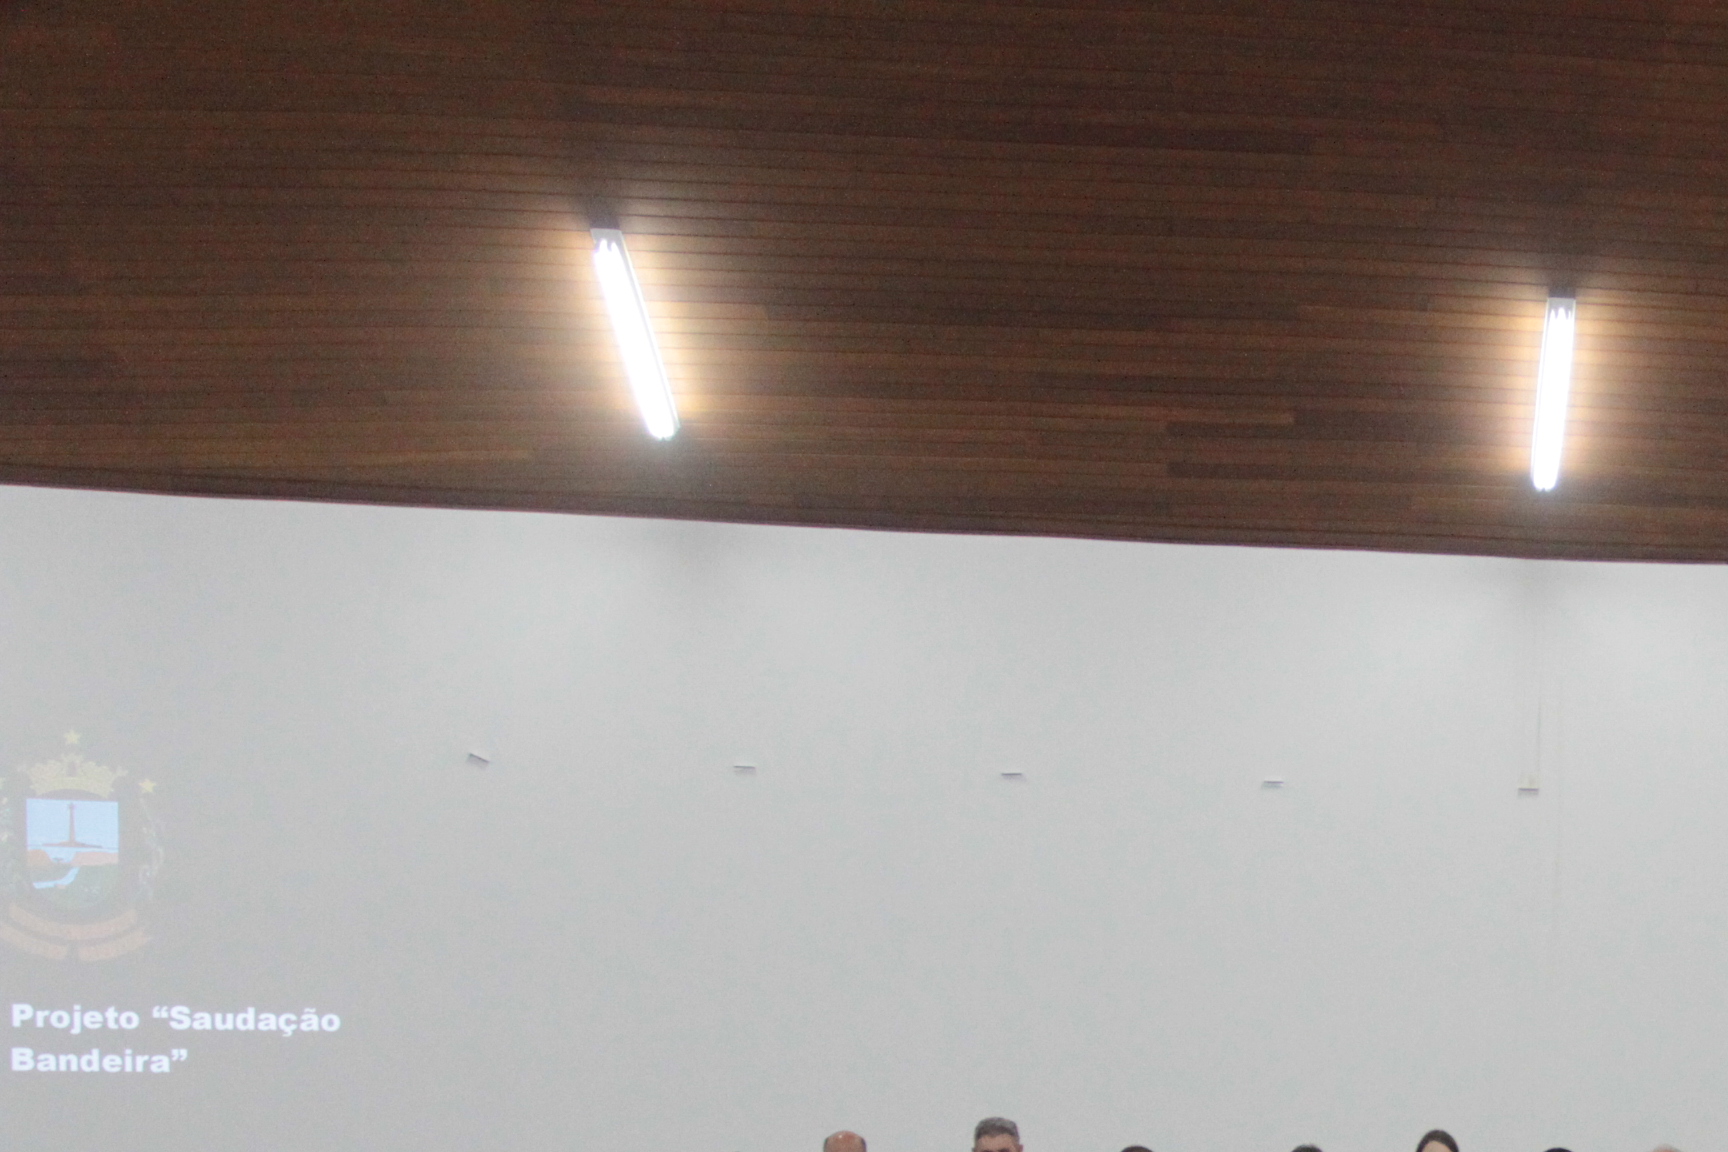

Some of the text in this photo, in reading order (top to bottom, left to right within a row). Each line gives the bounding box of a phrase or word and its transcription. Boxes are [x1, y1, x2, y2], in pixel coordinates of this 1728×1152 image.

[11, 1003, 341, 1037] Projeto “Saudação
[10, 1047, 188, 1073] Bandeira”
